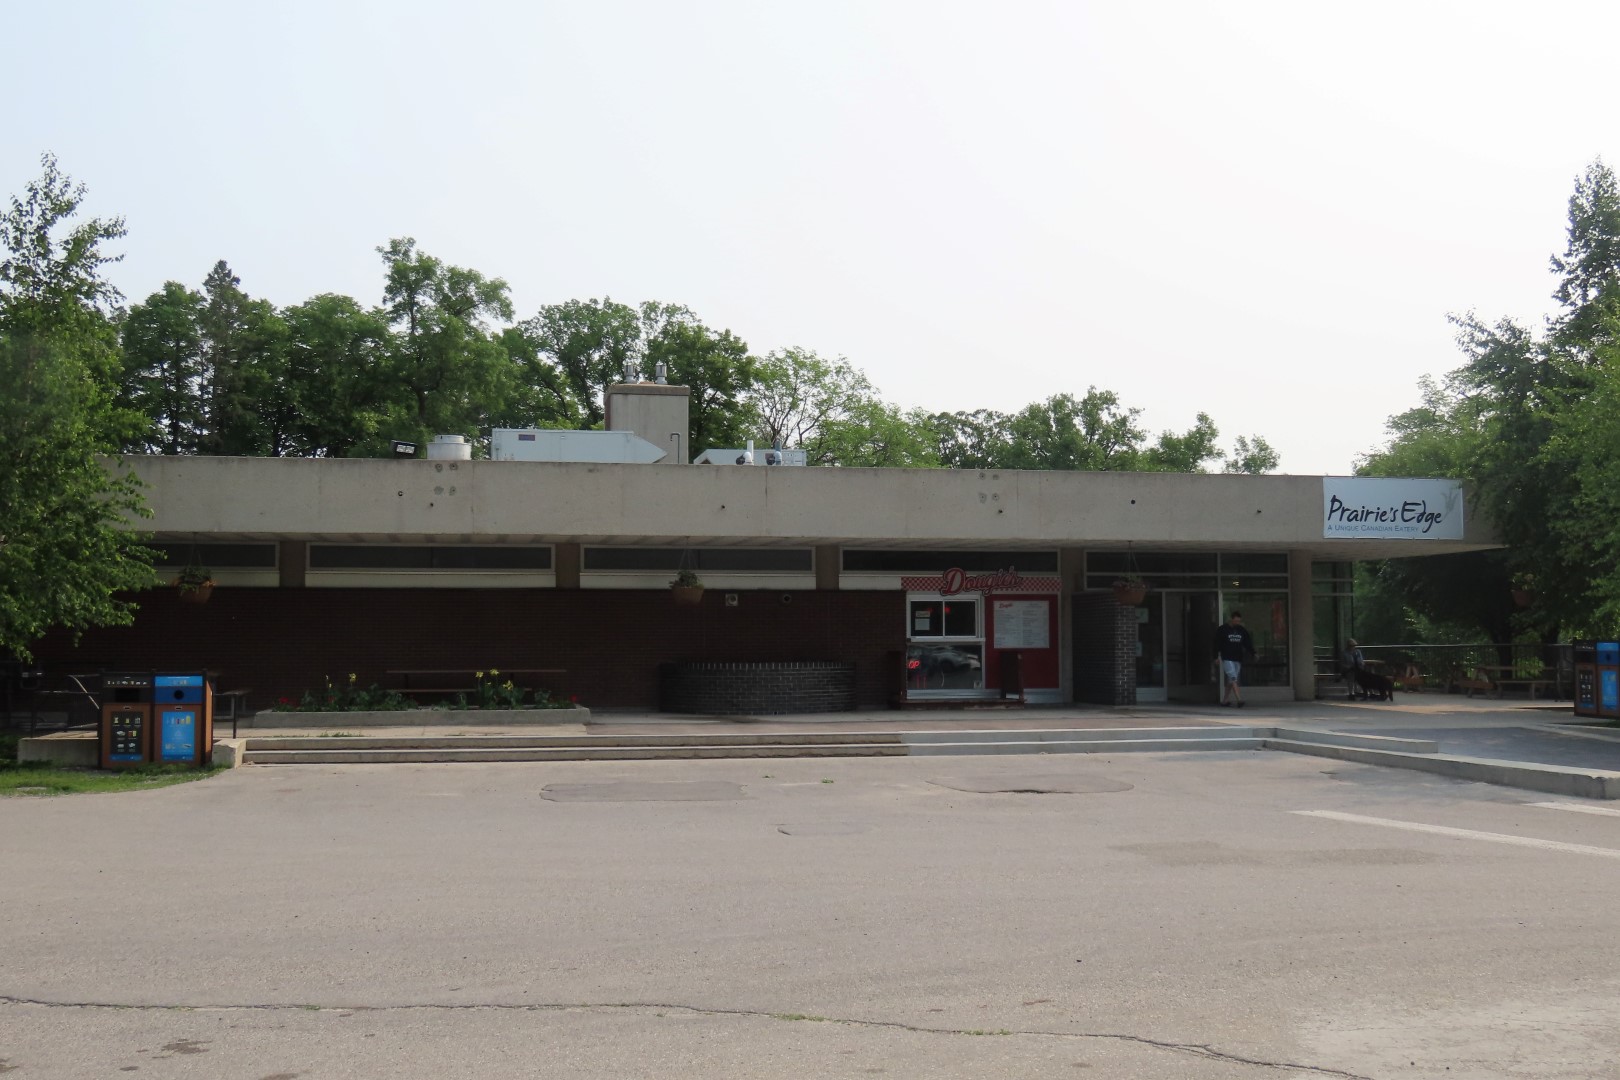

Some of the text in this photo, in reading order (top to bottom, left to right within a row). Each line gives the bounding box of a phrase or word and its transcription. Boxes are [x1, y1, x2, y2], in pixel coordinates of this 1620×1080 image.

[1327, 494, 1443, 534] Prairie's Edge
[1334, 524, 1360, 532] UNIQUE
[1360, 524, 1393, 533] CANADIAN
[1394, 525, 1419, 533] EATERY
[940, 565, 1022, 597] Dougie's
